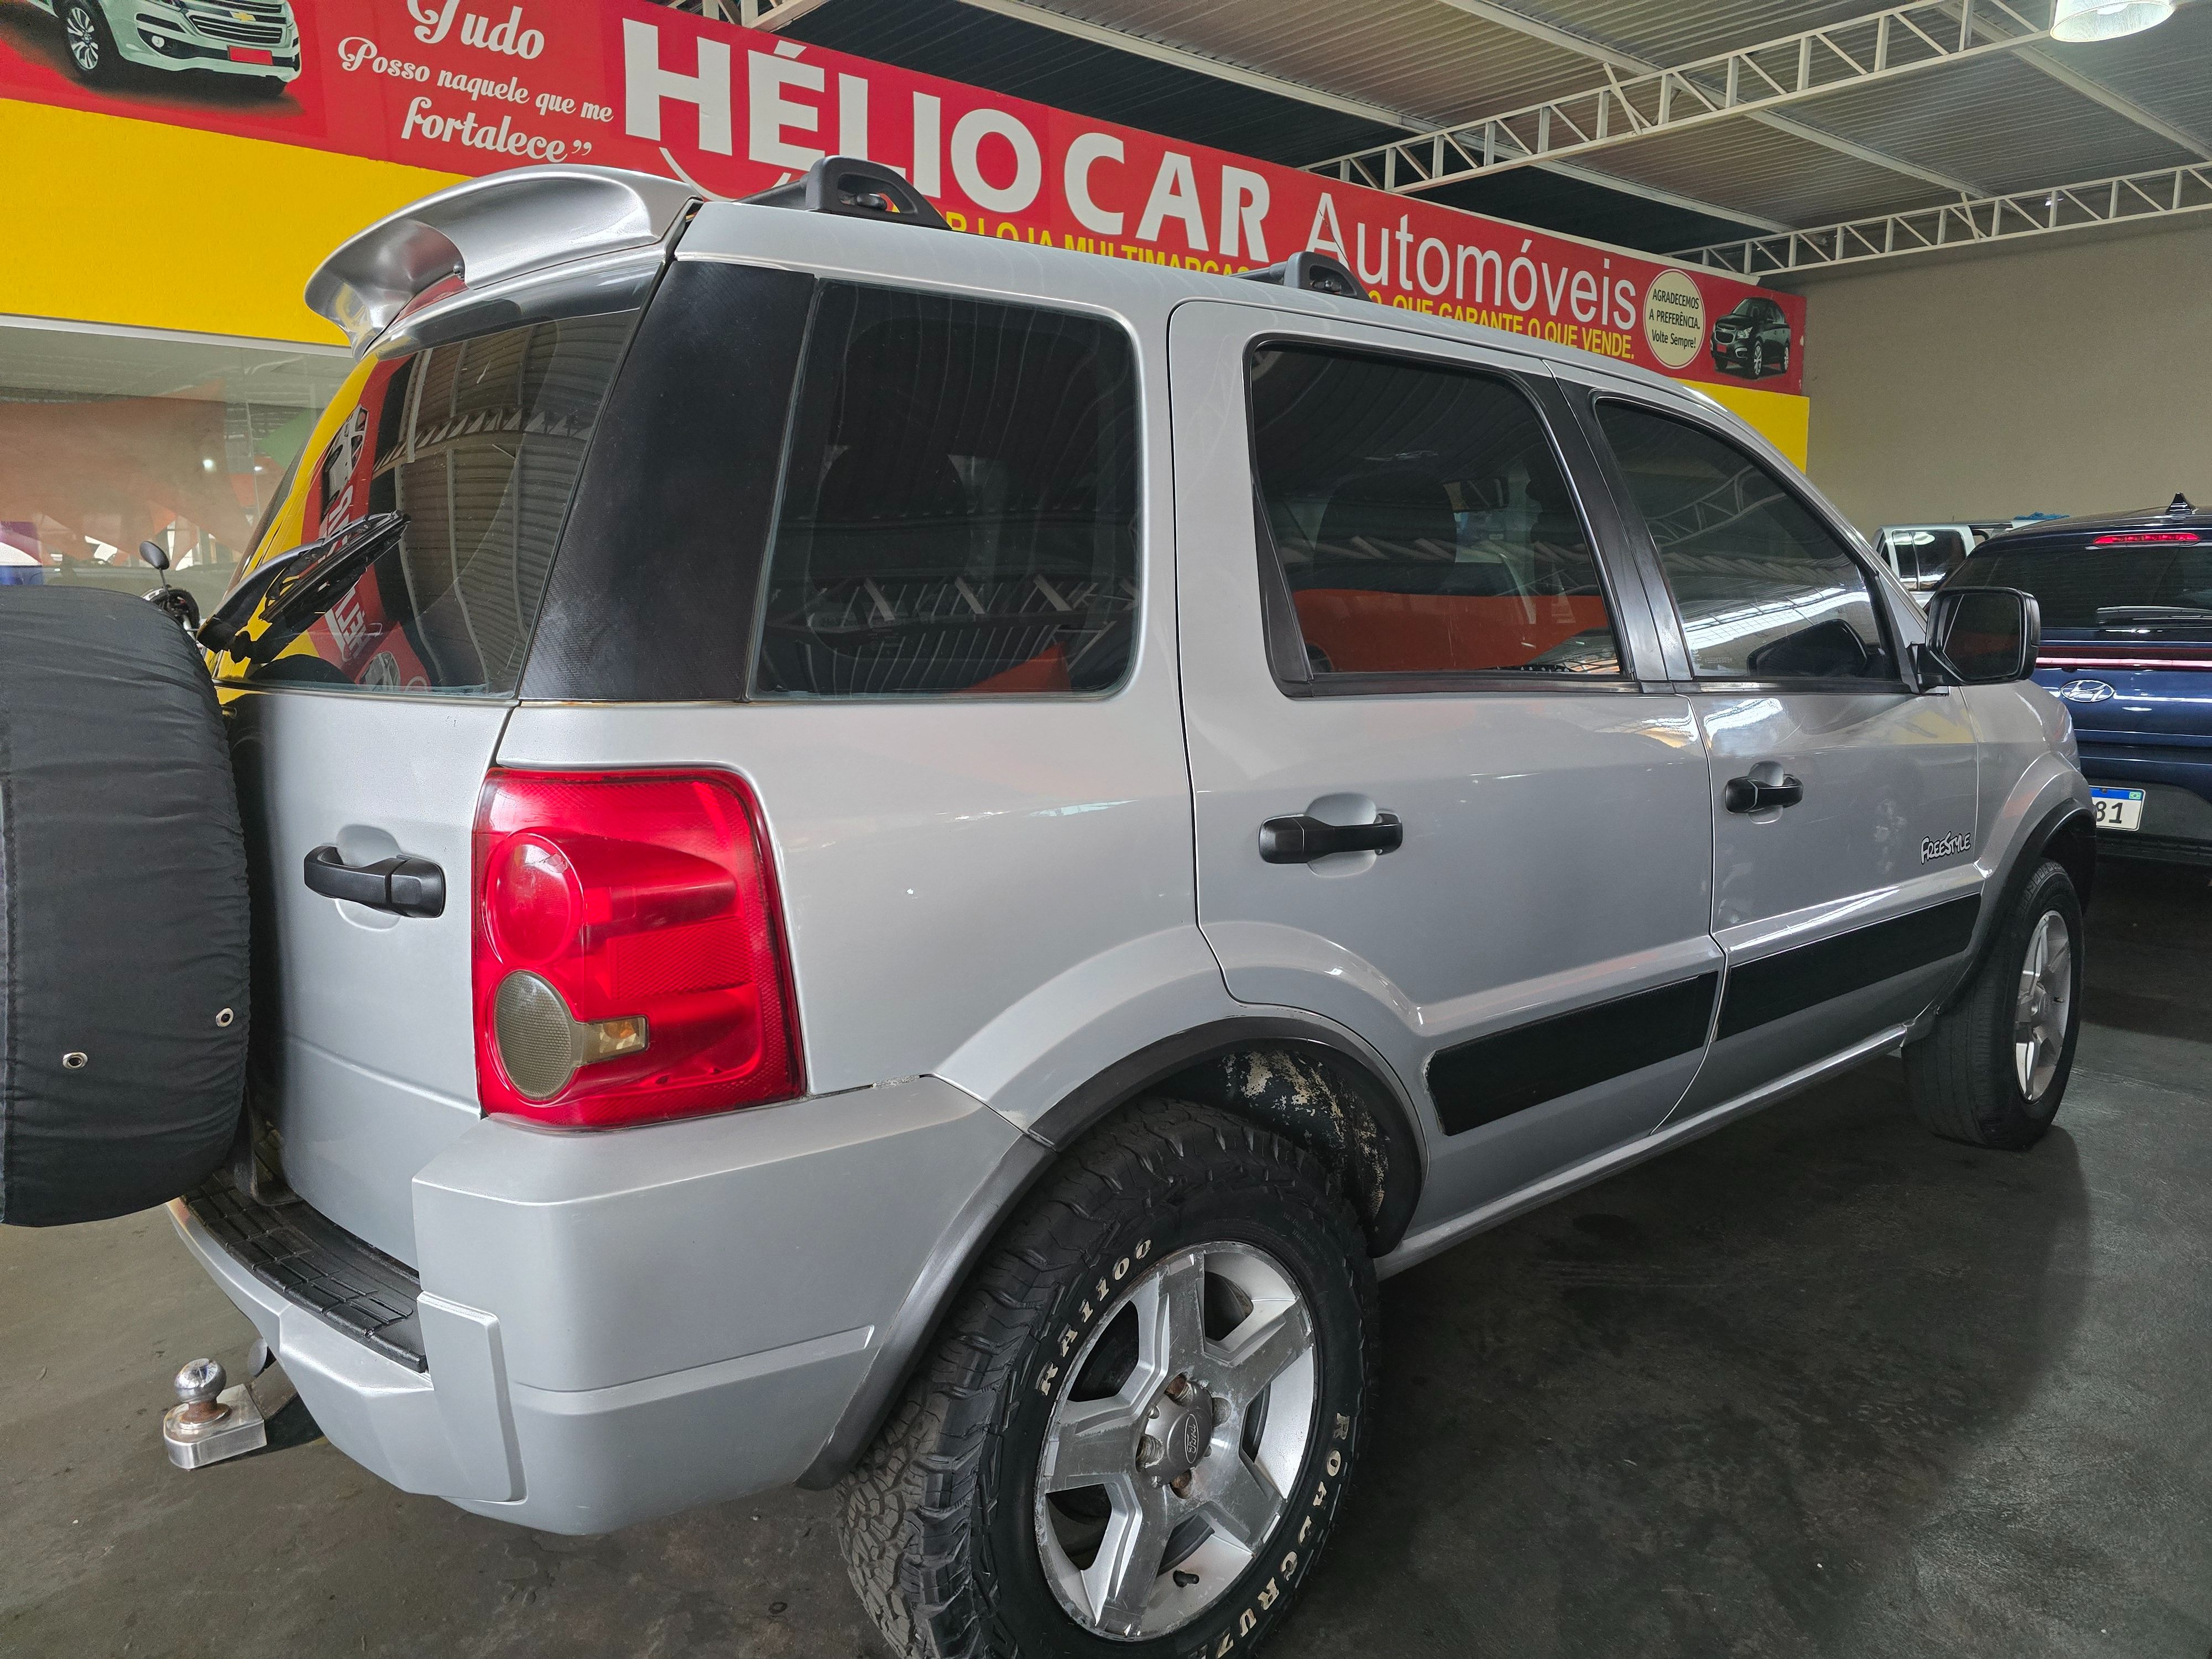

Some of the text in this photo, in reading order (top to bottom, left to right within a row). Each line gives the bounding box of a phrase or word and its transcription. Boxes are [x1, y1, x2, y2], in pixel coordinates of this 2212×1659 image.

[406, 0, 545, 60] Tudo
[337, 36, 614, 122] Posso naquele que me
[1305, 191, 1636, 330] Automóveis
[1652, 288, 1699, 310] AGRADECEMOS
[1648, 308, 1700, 330] A PREFERÊNCIA.
[1527, 318, 1541, 339] O
[1545, 321, 1578, 348] QUE
[1582, 327, 1634, 359] VENDE.
[1651, 329, 1697, 349] Volte Sempre!
[2095, 801, 2124, 824] 81
[1187, 1423, 1197, 1454] Ford
